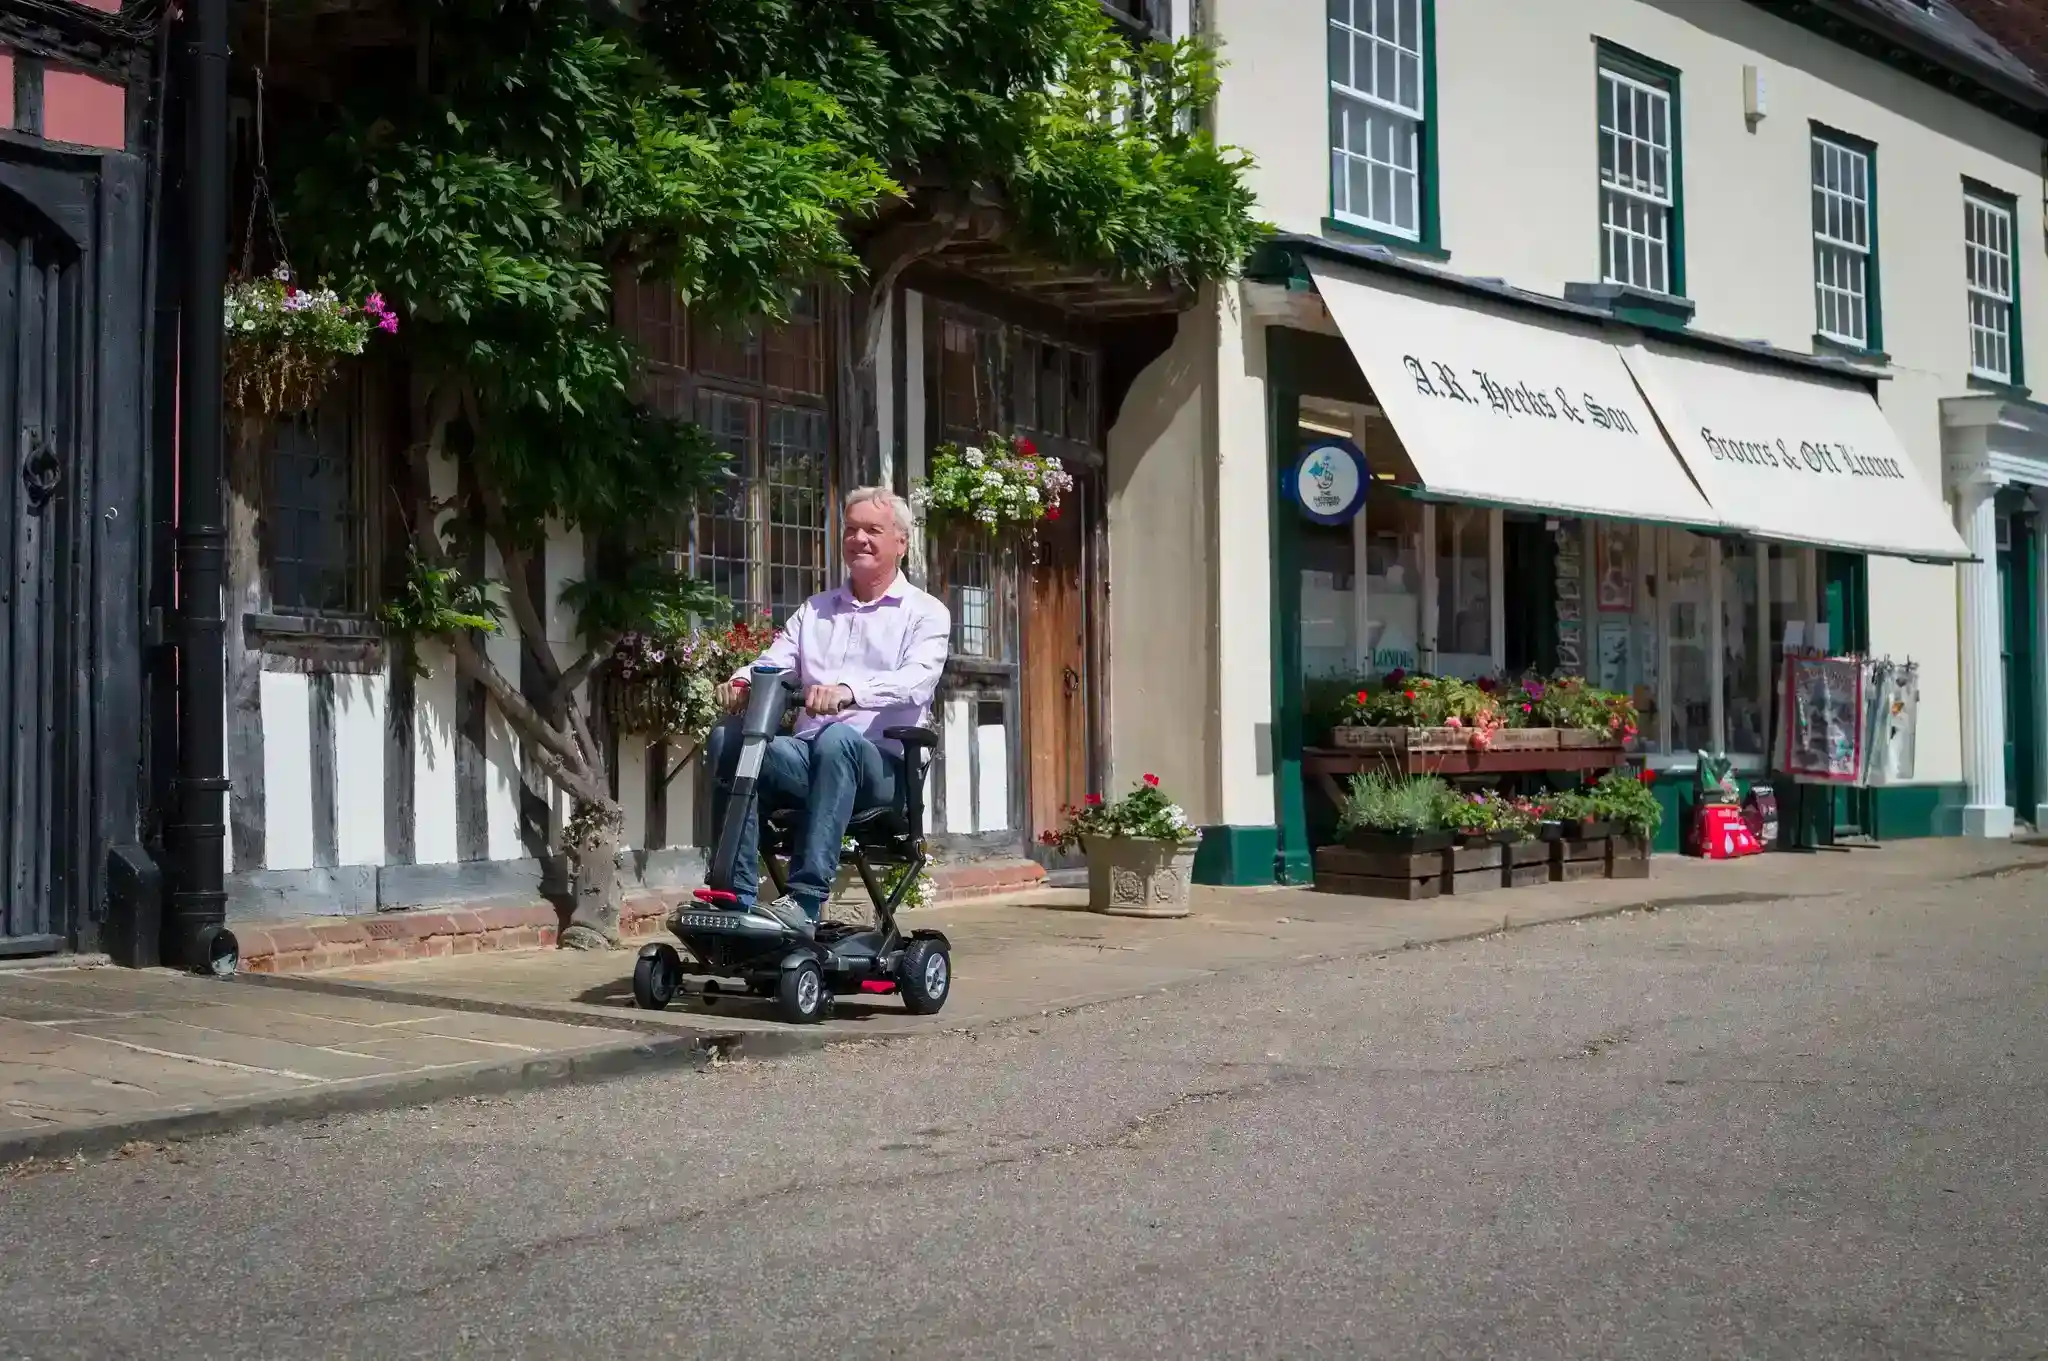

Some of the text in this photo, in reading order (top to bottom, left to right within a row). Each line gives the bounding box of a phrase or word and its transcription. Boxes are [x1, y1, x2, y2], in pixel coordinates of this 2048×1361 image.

[1402, 354, 1639, 436] A.R. Heeks & Son
[1700, 426, 1905, 480] Grocers & Off Licence
